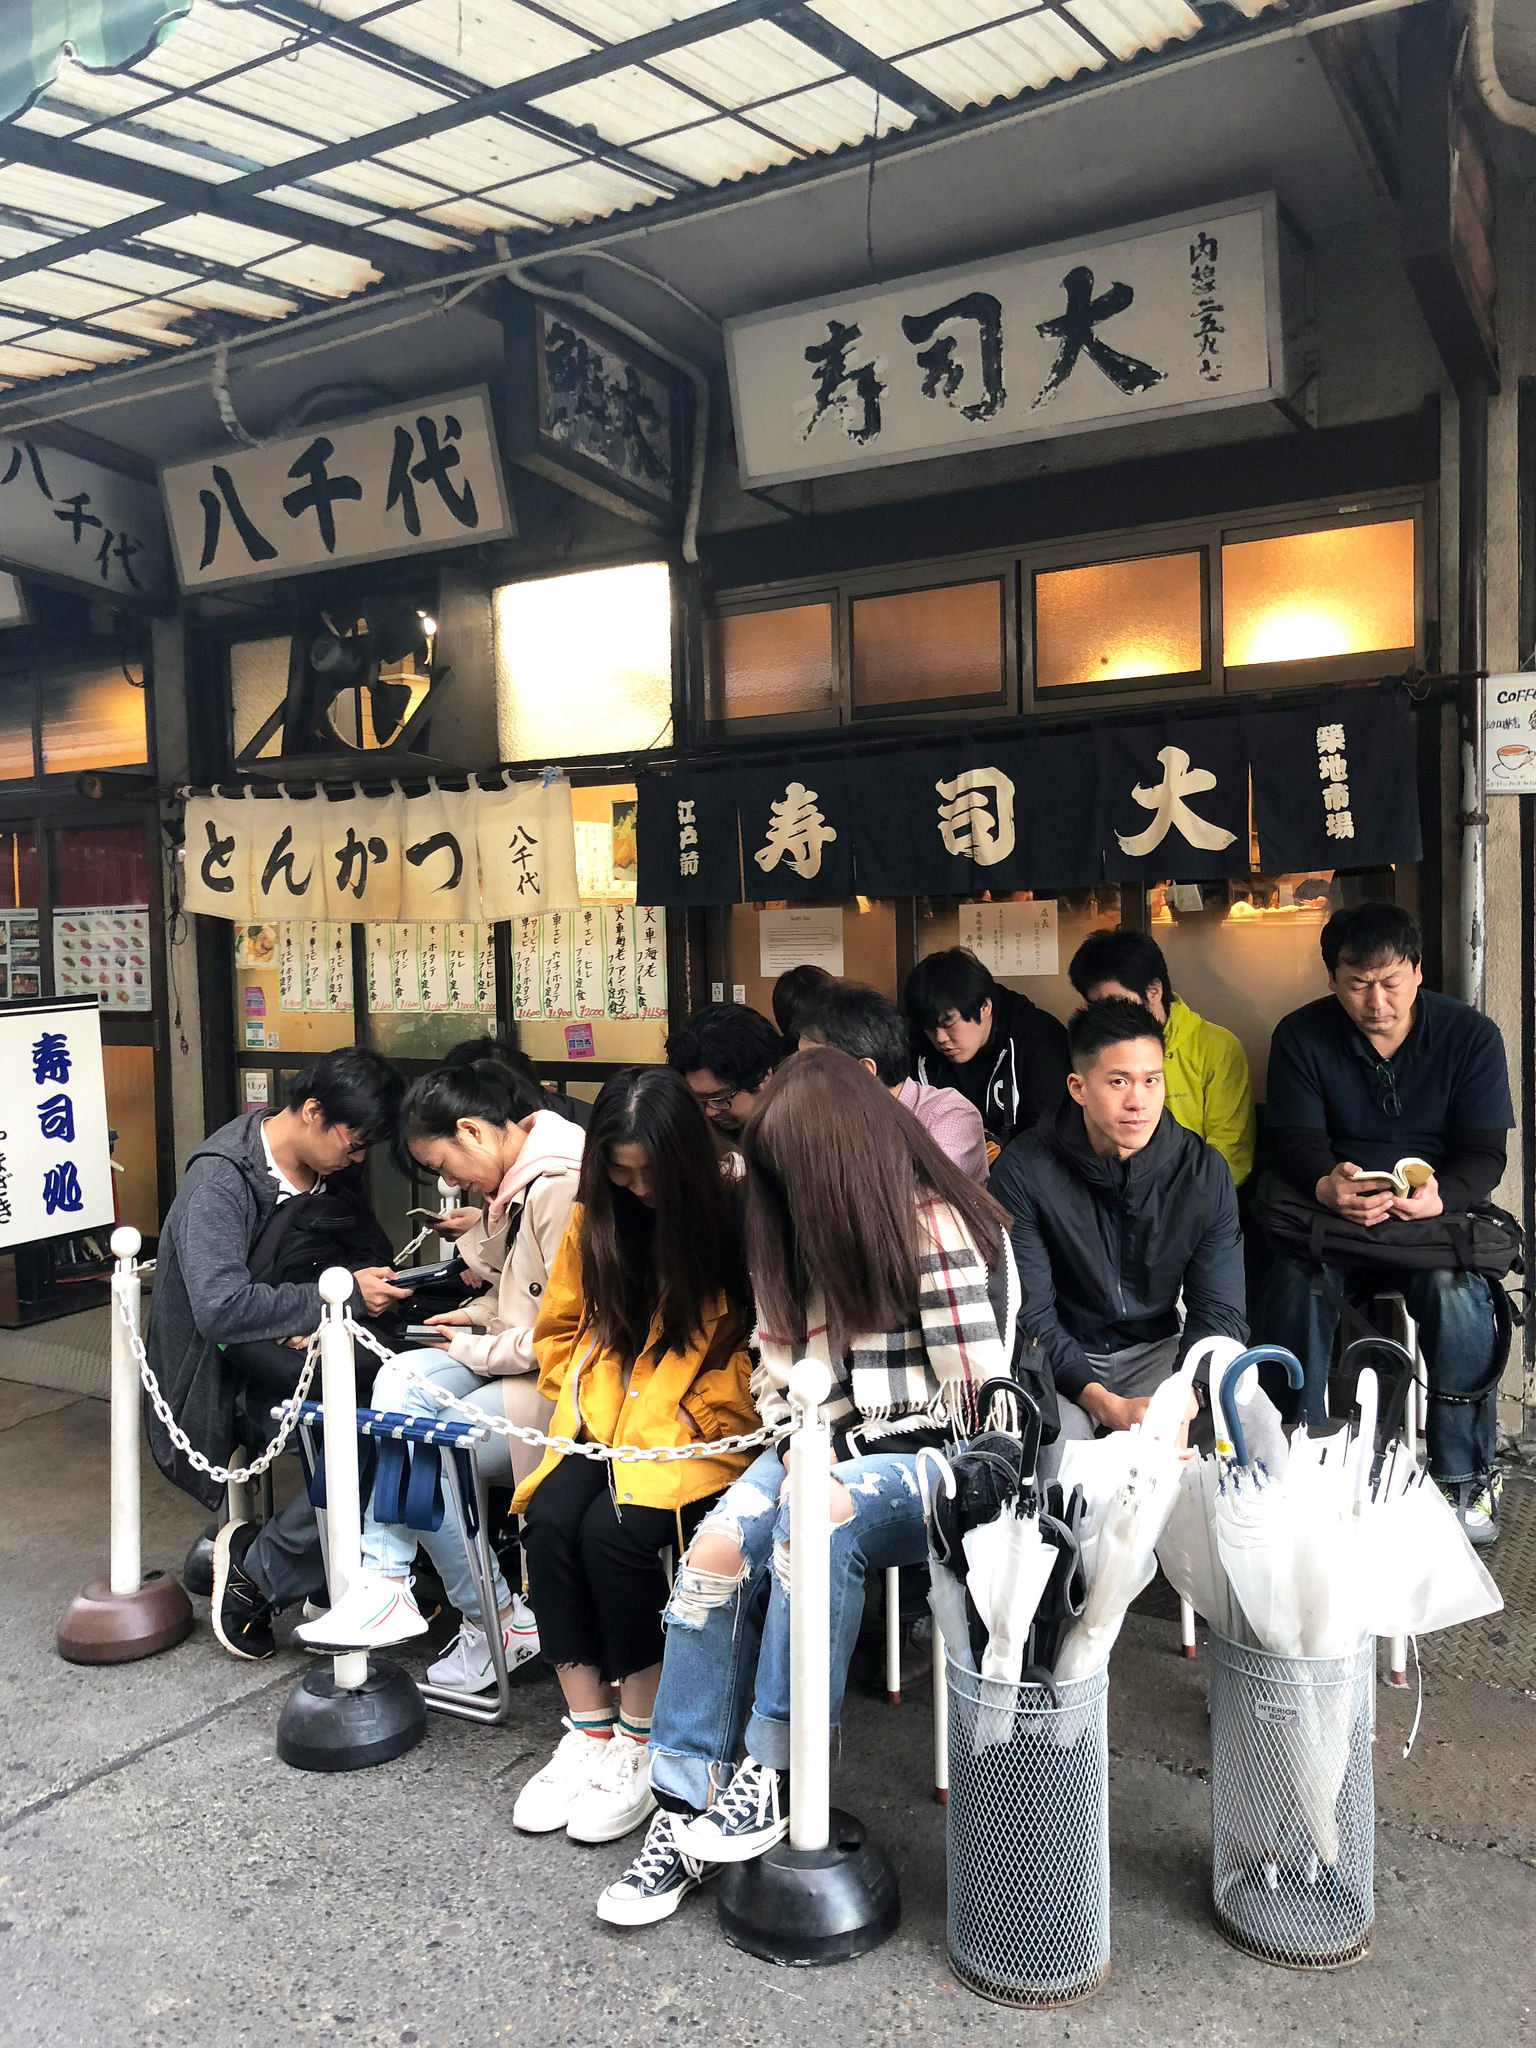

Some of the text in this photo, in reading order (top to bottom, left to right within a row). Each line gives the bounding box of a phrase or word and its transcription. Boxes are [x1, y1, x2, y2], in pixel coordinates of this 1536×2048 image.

[801, 266, 1169, 446] 寿司大
[0, 440, 145, 592] 八千代
[199, 415, 479, 571] 八千代
[754, 745, 1238, 880] 寿司大
[1316, 723, 1355, 840] 築地市場
[200, 820, 464, 900] とんかつ
[509, 826, 541, 895] 八千代
[677, 799, 700, 877] 江戸前
[1258, 1704, 1298, 1716] INTERIOR
[1268, 1713, 1287, 1721] BOX
